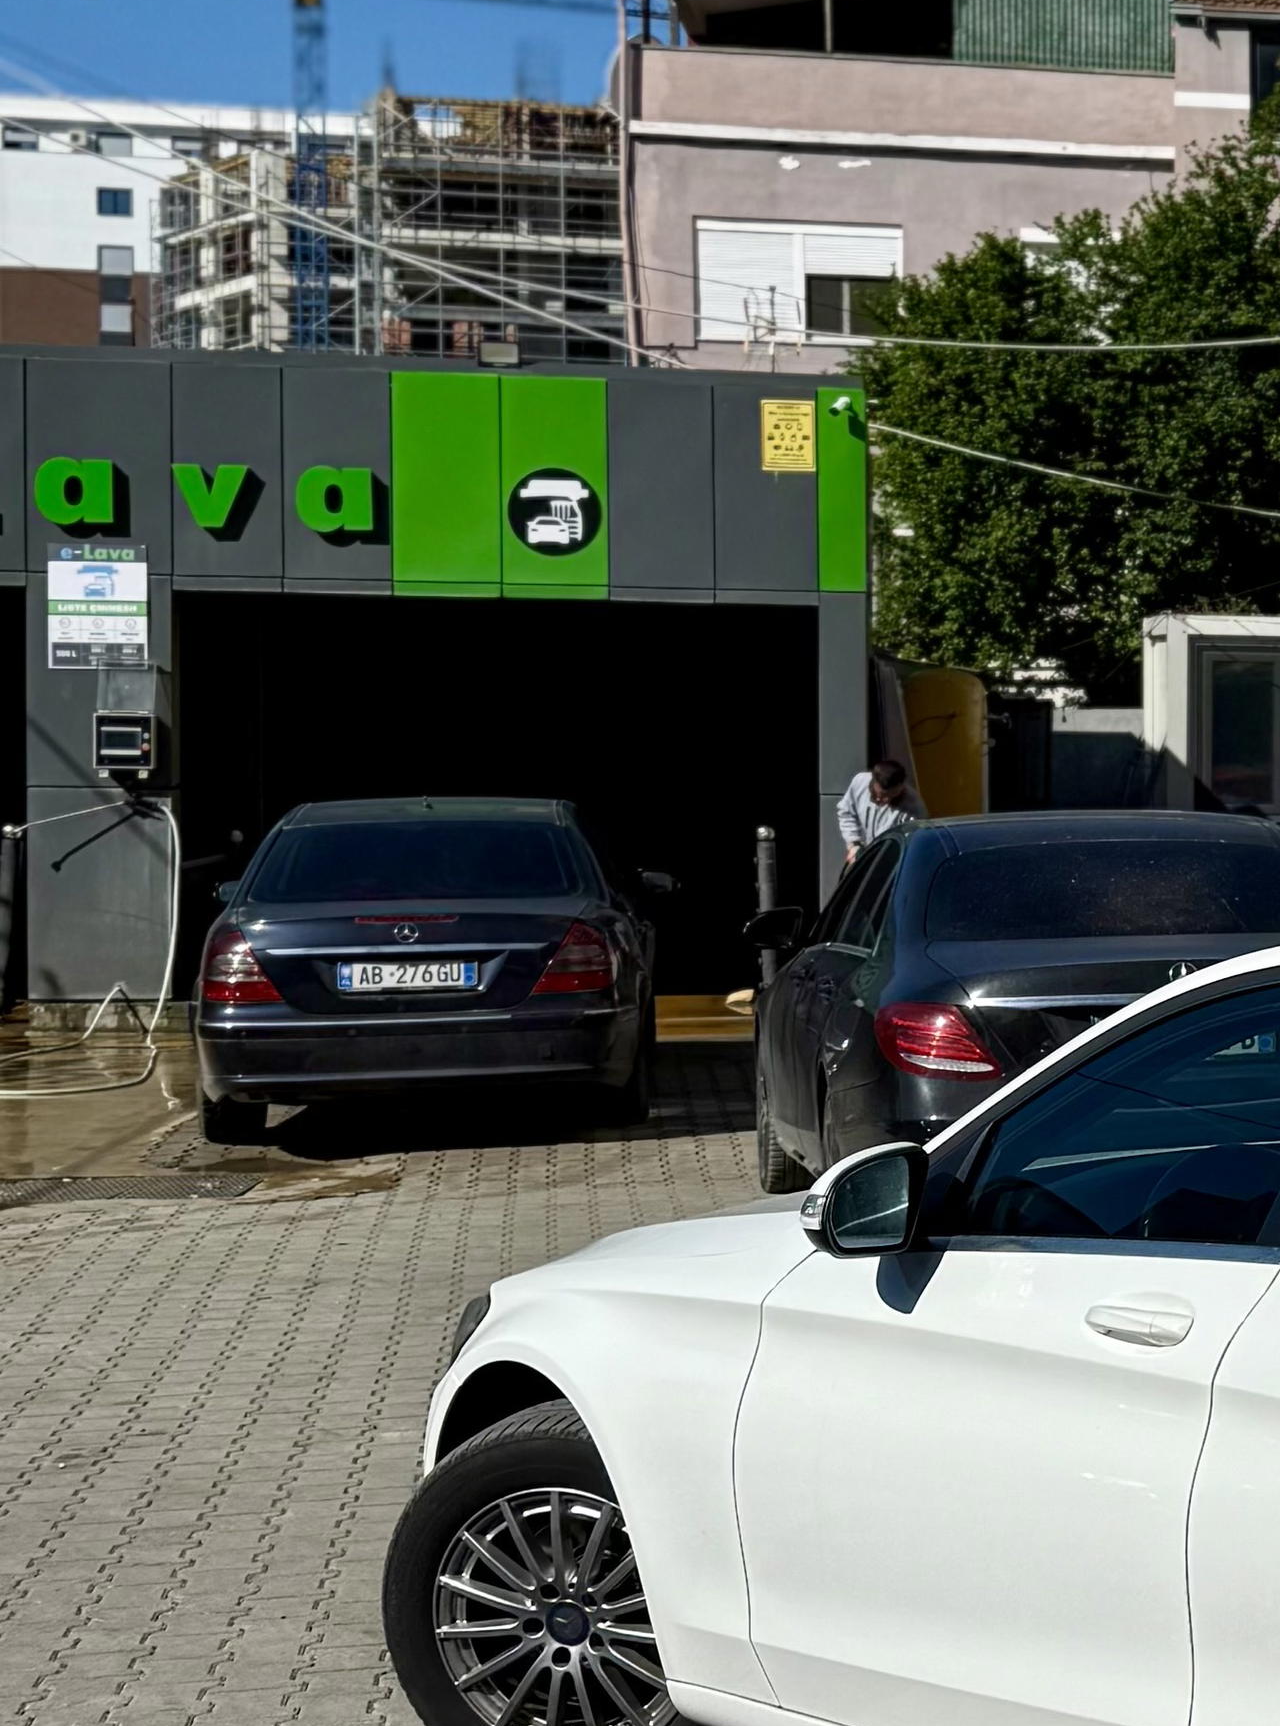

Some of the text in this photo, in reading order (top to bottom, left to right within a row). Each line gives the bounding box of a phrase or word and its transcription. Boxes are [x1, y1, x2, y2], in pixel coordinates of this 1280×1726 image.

[60, 544, 135, 561] e-Lava
[360, 966, 383, 985] AB
[396, 965, 433, 984] 276
[437, 961, 461, 982] GU
